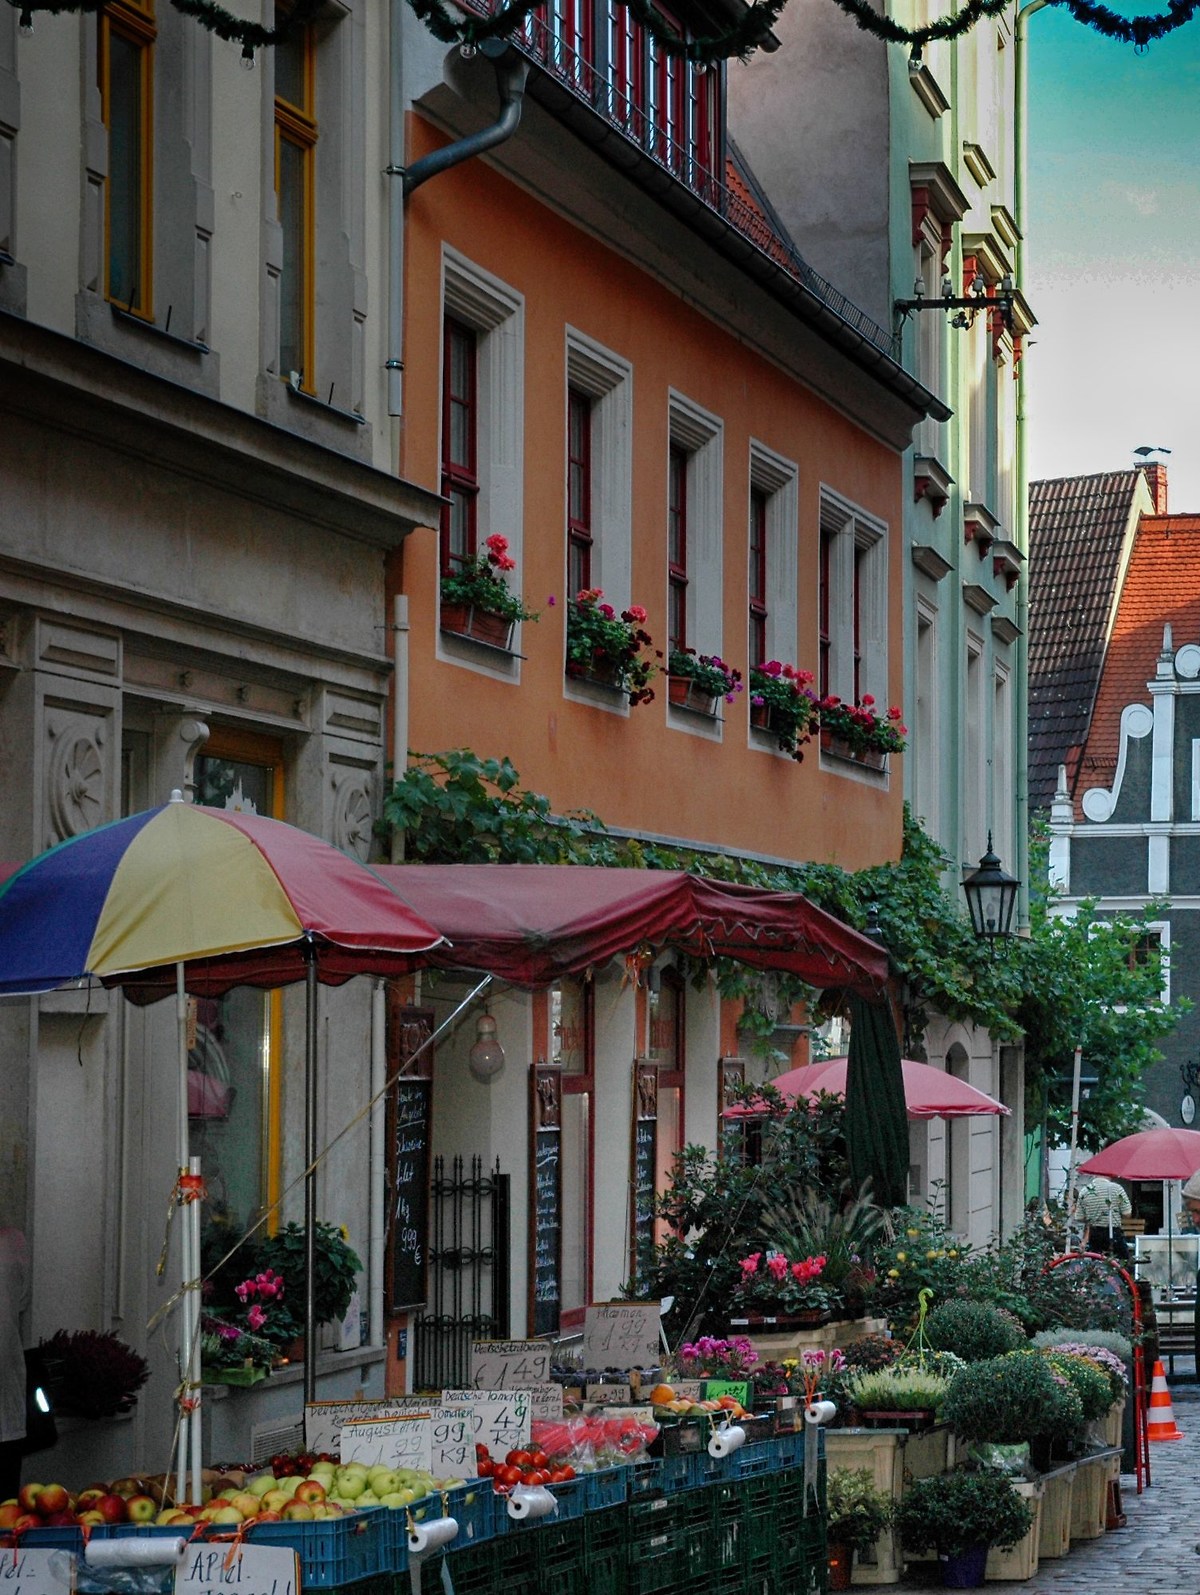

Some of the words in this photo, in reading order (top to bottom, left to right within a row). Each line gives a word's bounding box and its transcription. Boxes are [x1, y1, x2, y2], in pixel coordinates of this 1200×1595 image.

[513, 1356, 546, 1380] 49
[494, 1406, 527, 1429] 49
[434, 1423, 466, 1444] 99
